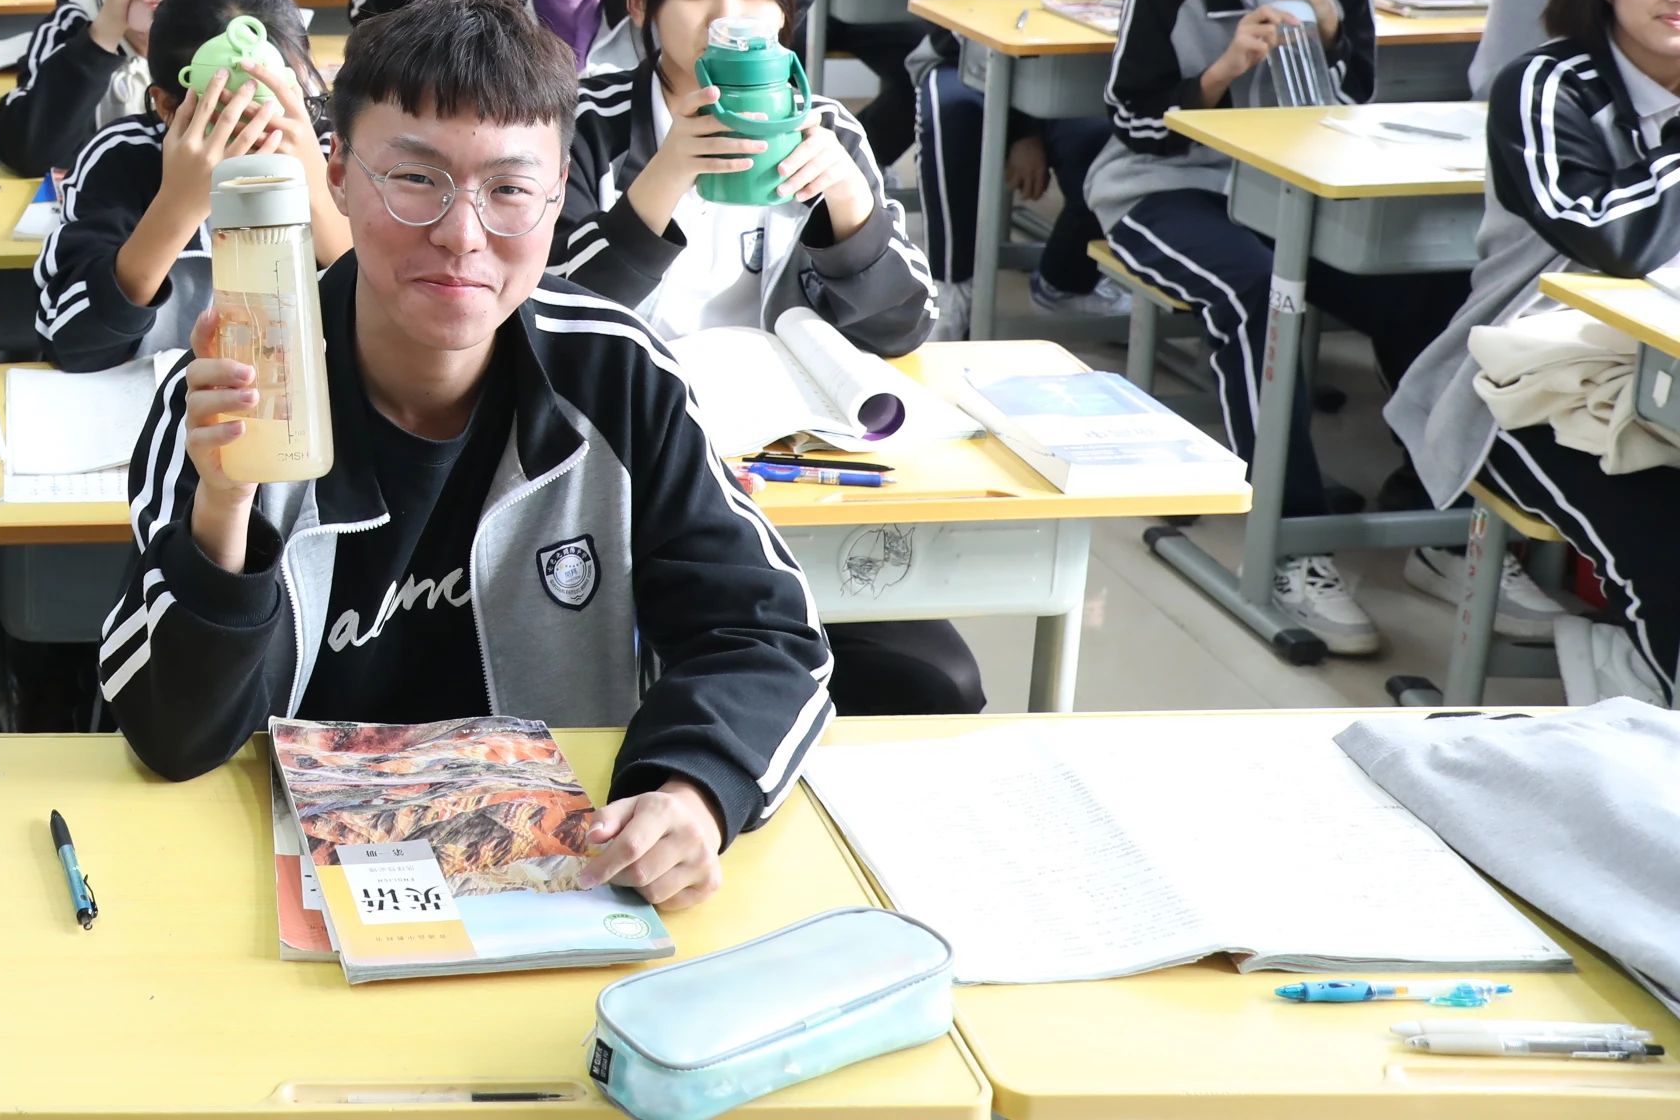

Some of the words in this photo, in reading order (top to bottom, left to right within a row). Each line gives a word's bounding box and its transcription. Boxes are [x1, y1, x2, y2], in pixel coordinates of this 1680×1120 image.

[366, 848, 405, 857] 第一册
[360, 885, 448, 914] 英语
